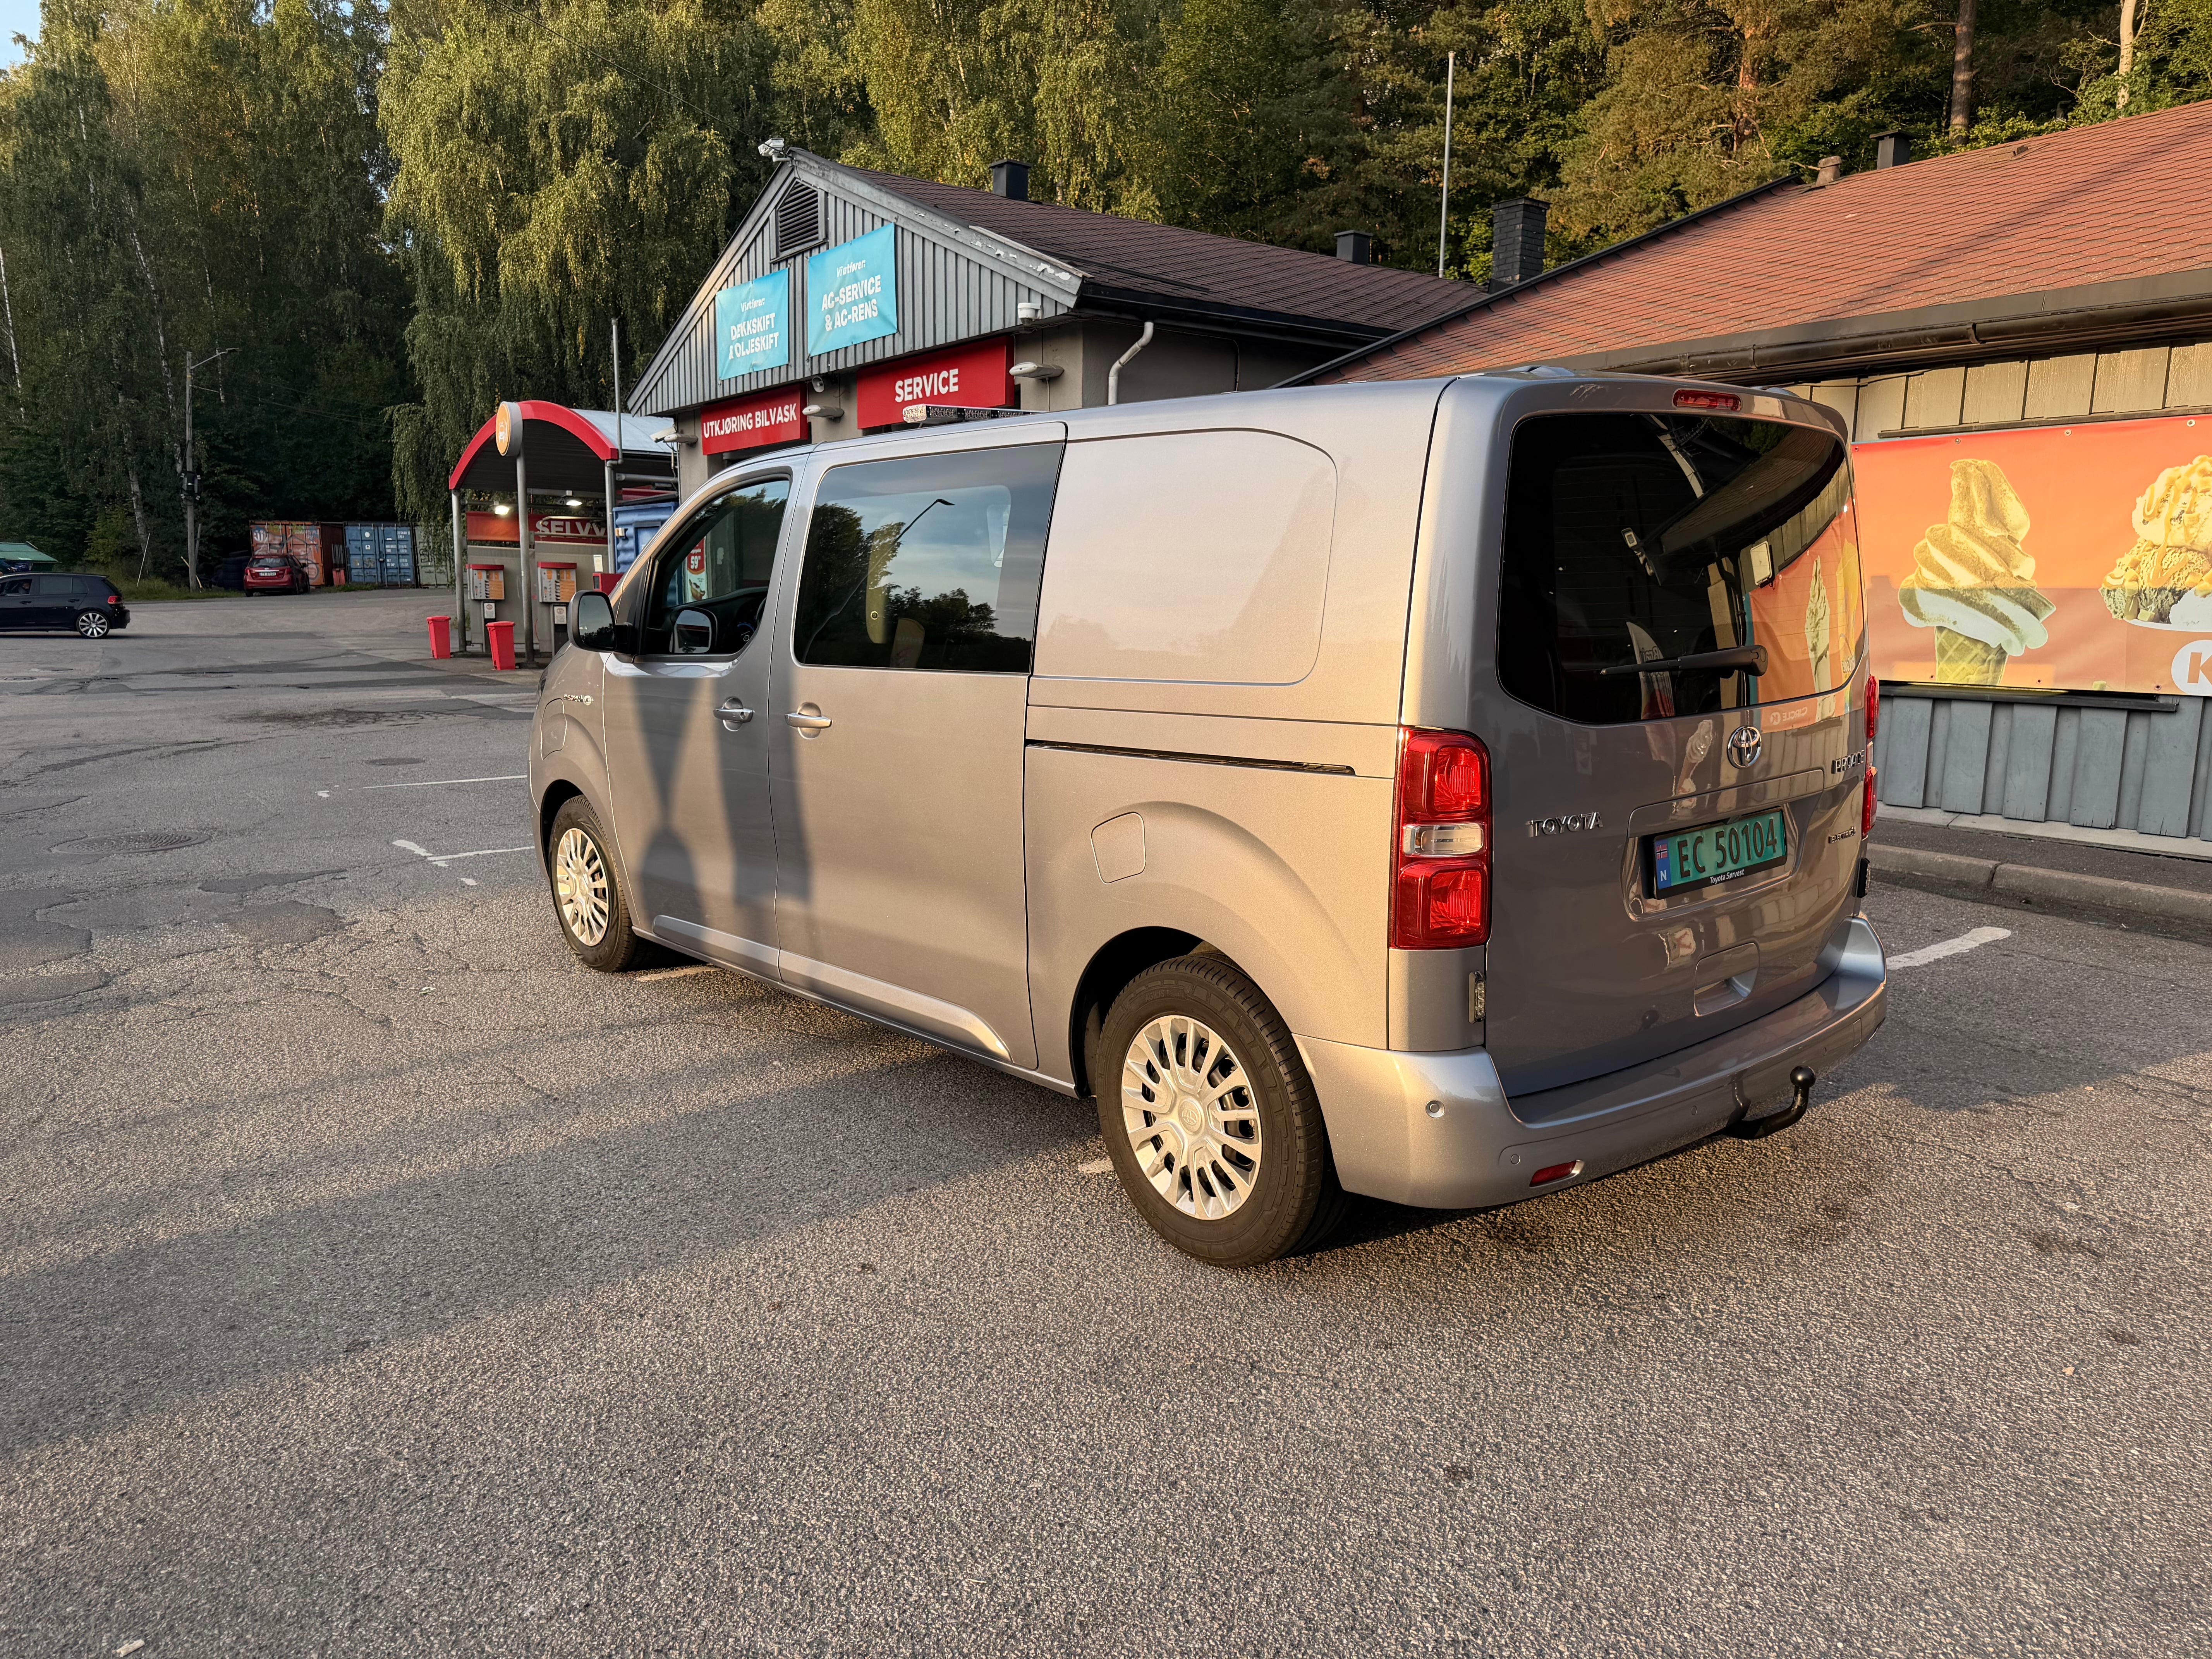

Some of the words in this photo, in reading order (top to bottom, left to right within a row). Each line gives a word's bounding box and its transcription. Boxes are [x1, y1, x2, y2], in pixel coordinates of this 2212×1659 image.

[821, 275, 881, 311] AC-SERVICE
[731, 313, 775, 340] DEKKSKIFT
[825, 314, 832, 331] &
[834, 299, 878, 329] AC-RENS
[735, 332, 779, 358] OLJESKIFT
[895, 368, 958, 403] SERVICE
[703, 413, 753, 438] UTKJØRING
[755, 403, 797, 428] BILVASK
[1531, 812, 1603, 837] TOYOTA
[1678, 836, 1705, 878] EC
[1716, 818, 1777, 868] 50104
[1660, 870, 1667, 881] N
[1710, 874, 1726, 884] Toyota
[1726, 869, 1744, 879] Sørvest
[1145, 990, 1165, 1002] AGILIS
